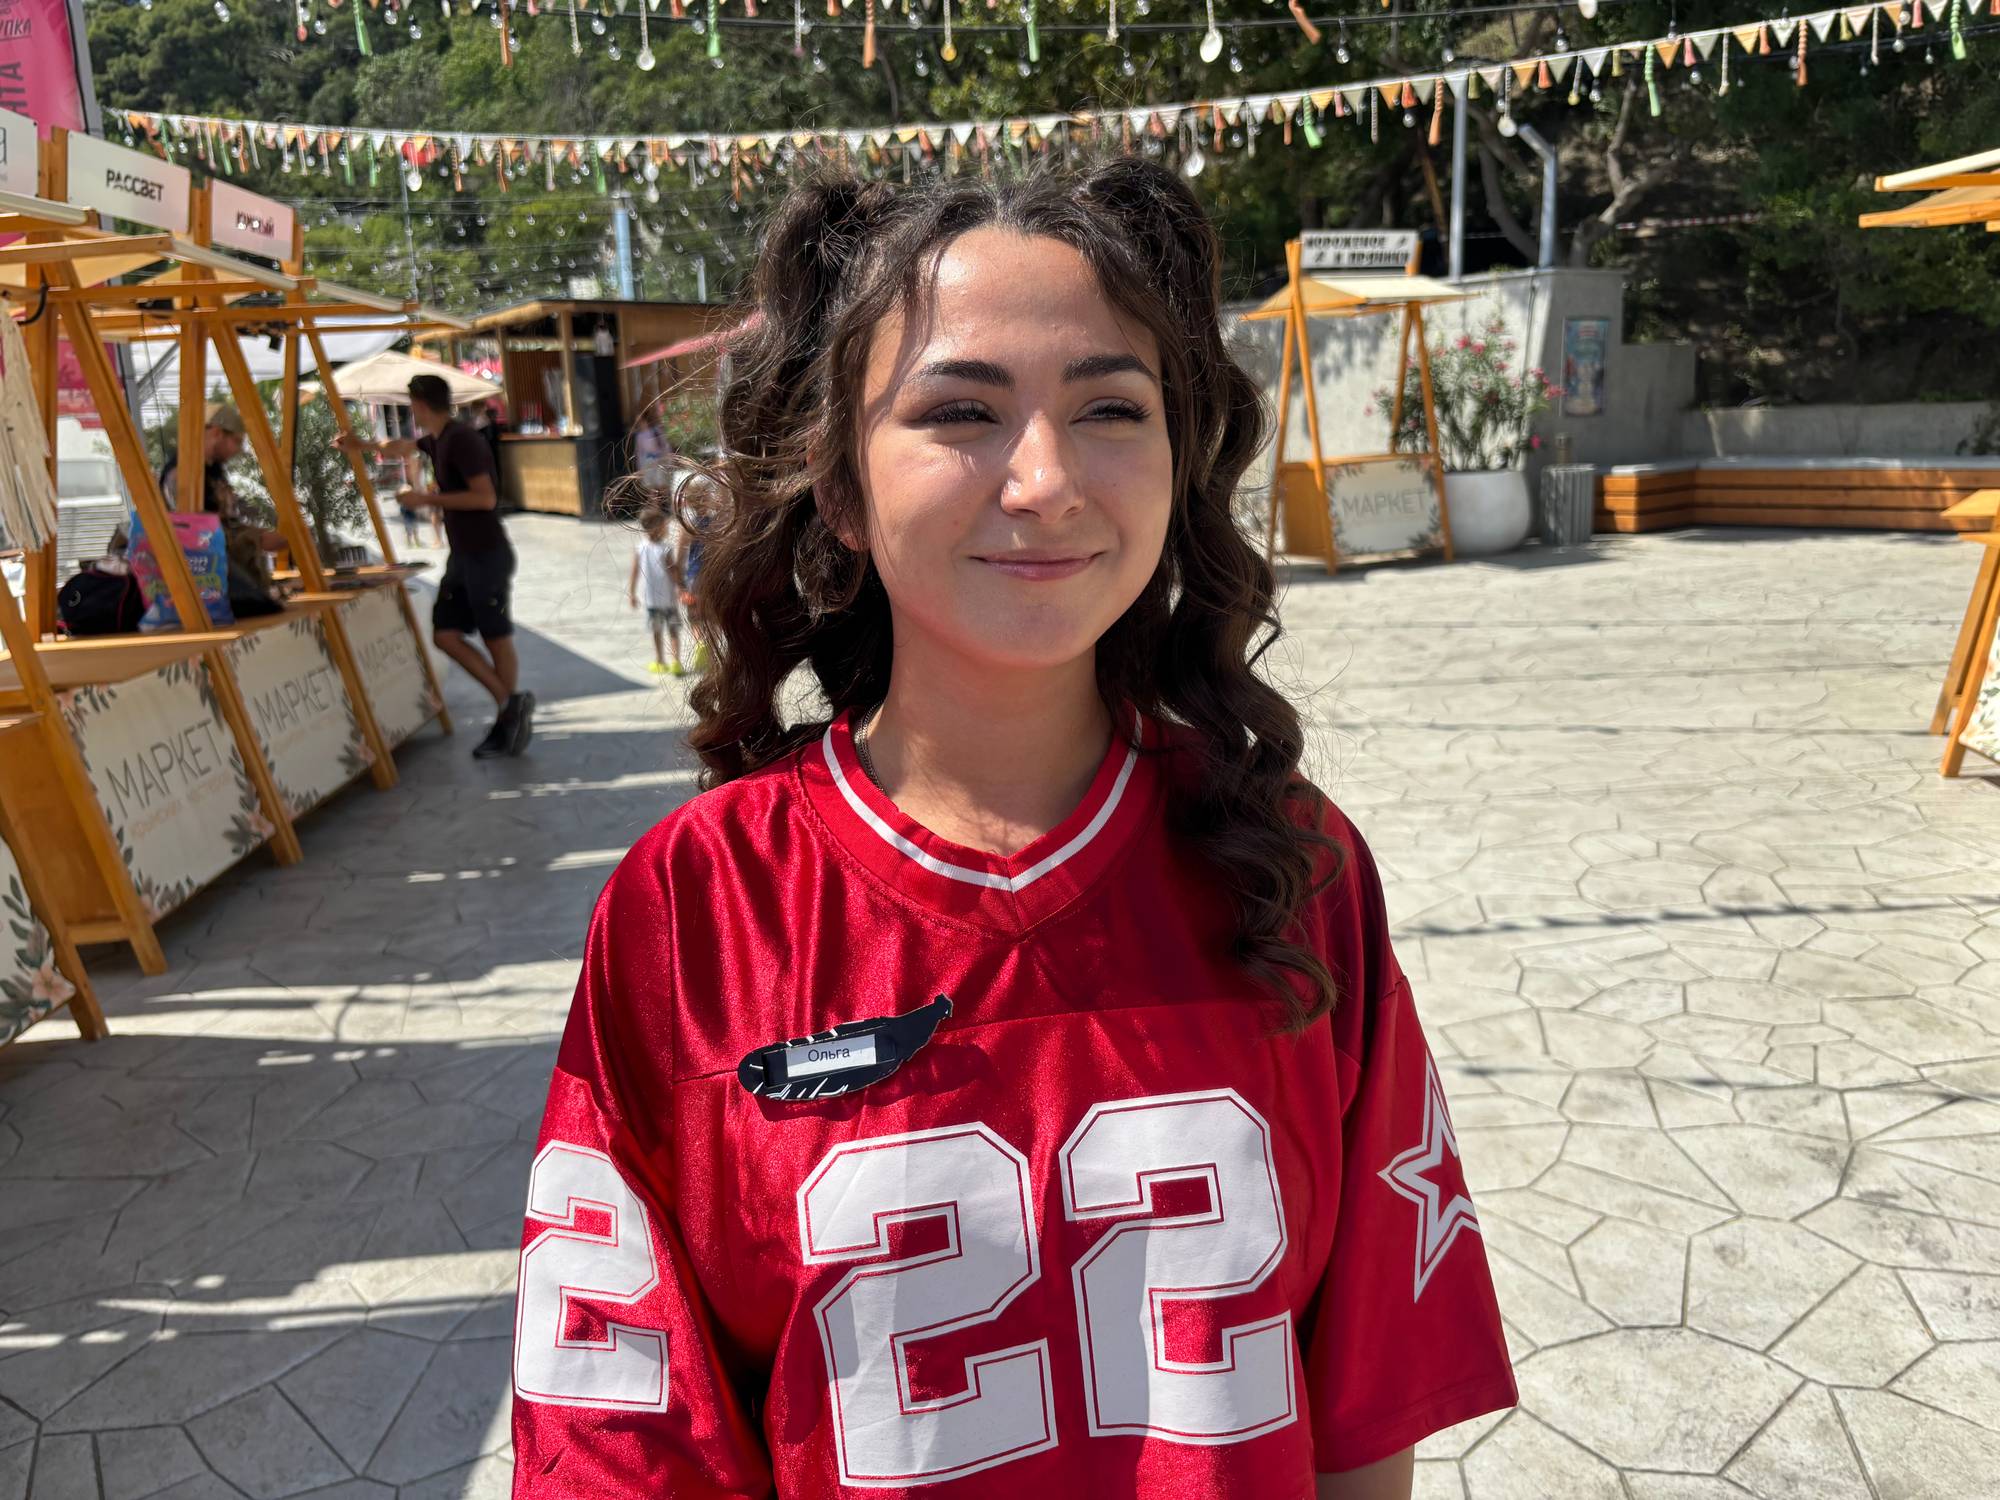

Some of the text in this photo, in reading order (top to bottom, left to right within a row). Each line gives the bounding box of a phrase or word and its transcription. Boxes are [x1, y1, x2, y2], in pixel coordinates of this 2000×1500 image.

[106, 168, 164, 202] РАССВЕТ
[1342, 489, 1427, 516] МАРКЕТ
[253, 664, 337, 737] МАРКЕТ
[106, 718, 222, 819] МАРКЕТ
[808, 1047, 851, 1062] Ольга
[514, 1139, 669, 1413] 2
[797, 1087, 1298, 1488] 22
